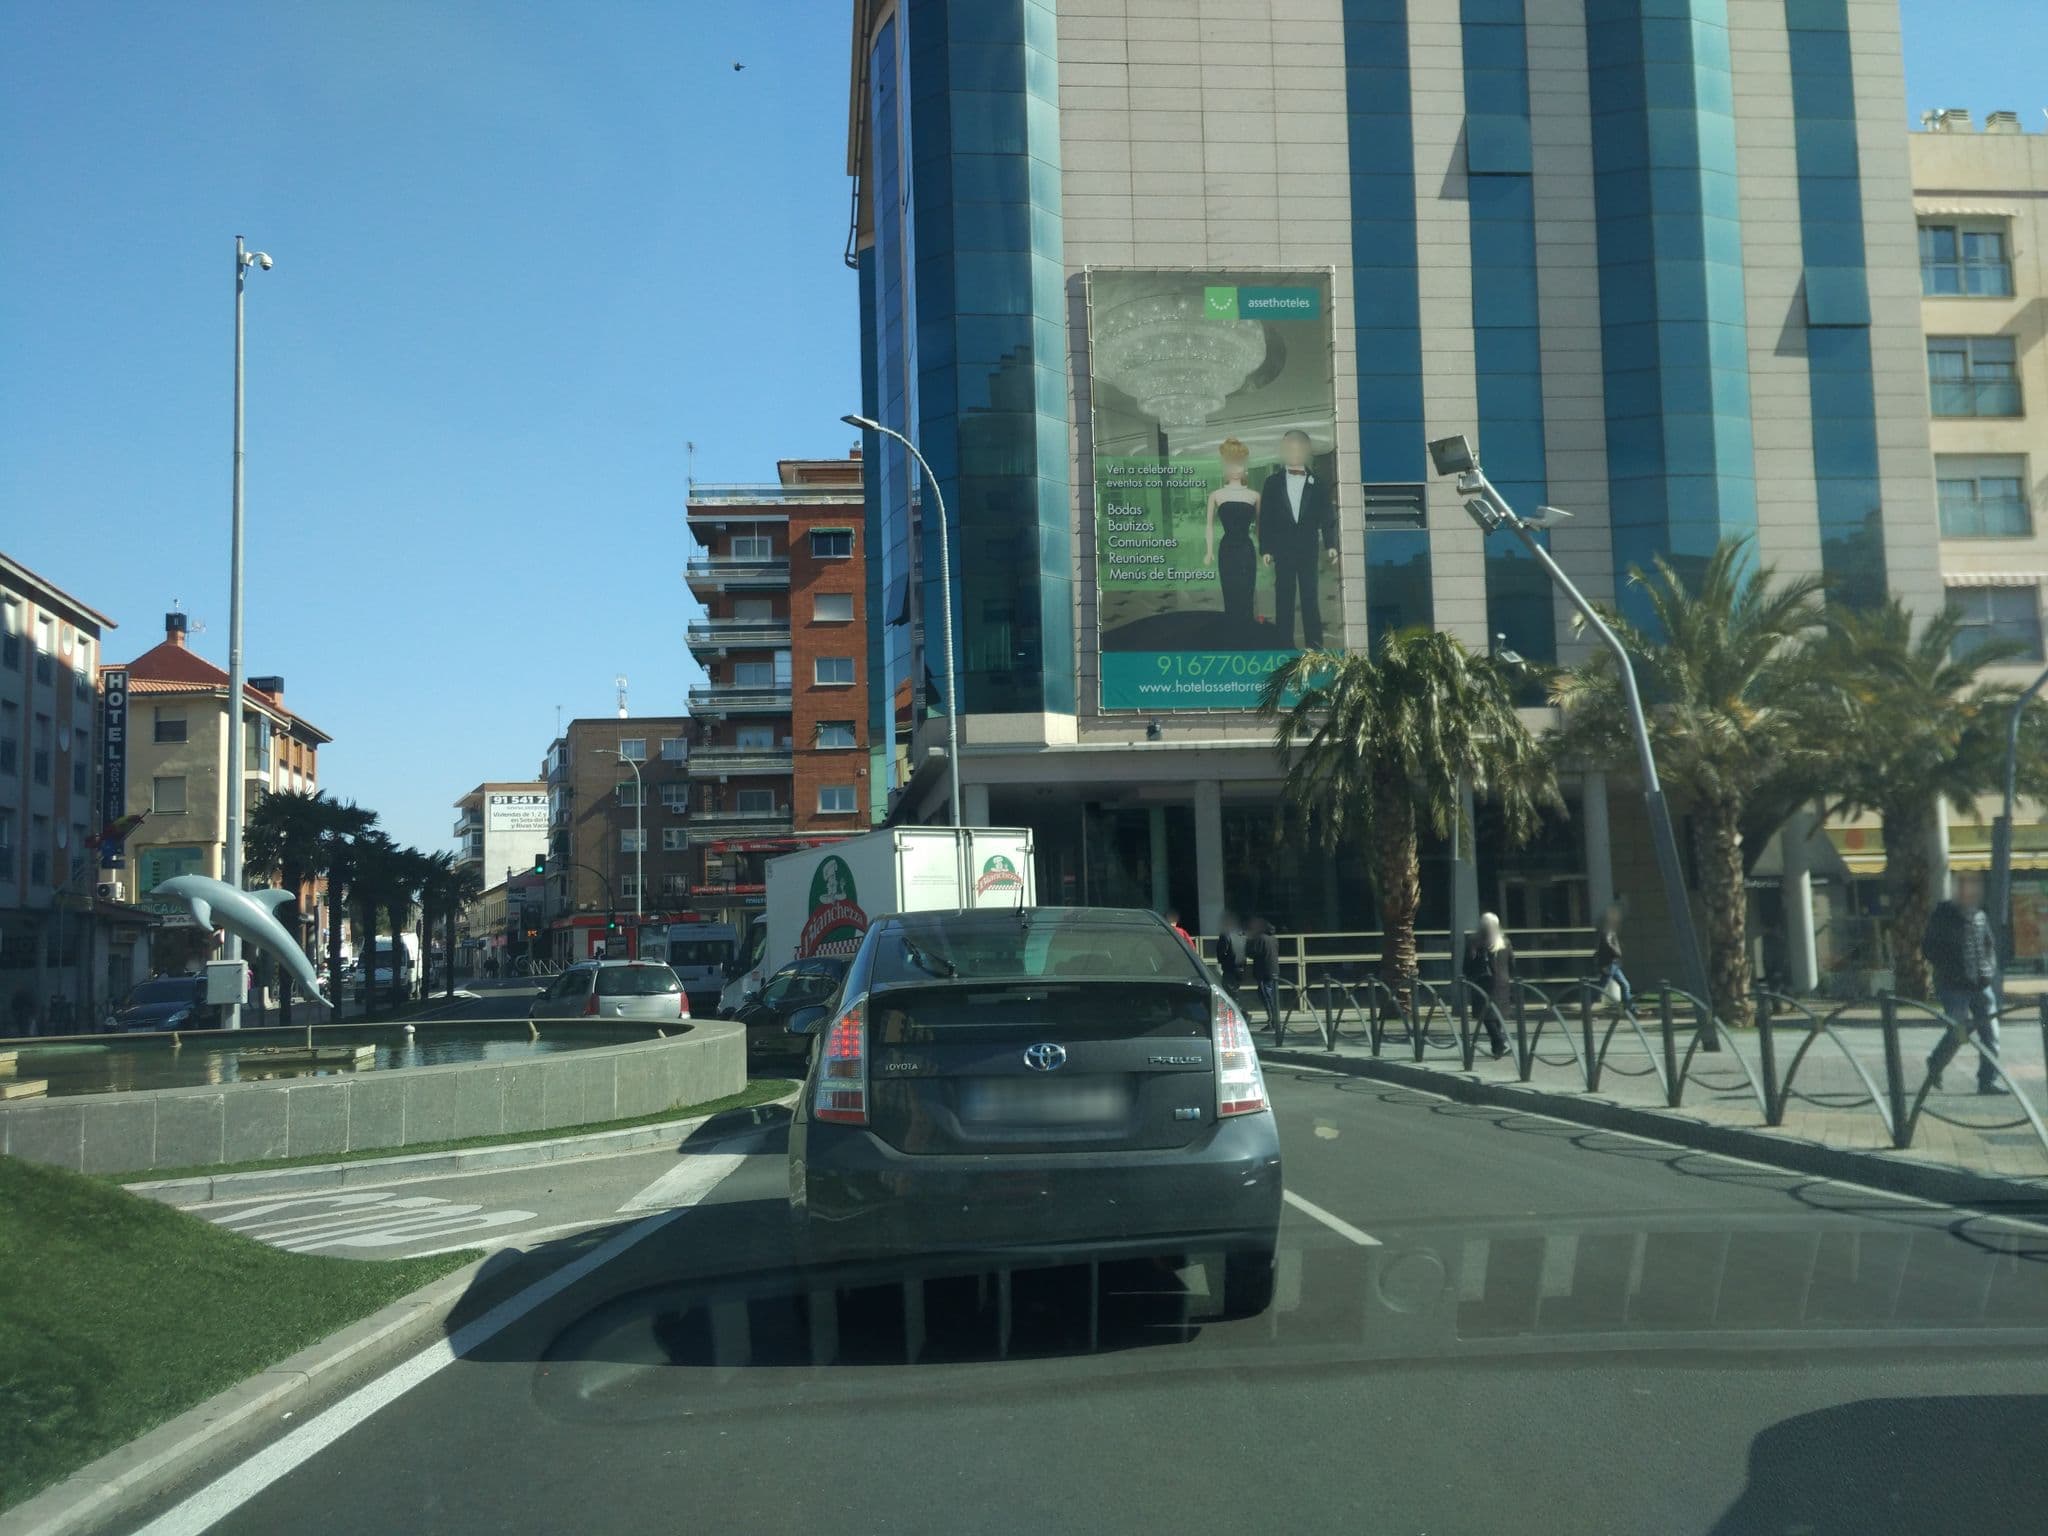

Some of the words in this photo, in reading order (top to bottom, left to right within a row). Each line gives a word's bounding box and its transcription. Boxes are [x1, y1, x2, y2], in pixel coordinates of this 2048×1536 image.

[1247, 297, 1310, 308] assethoteles
[1106, 464, 1125, 474] Ven
[1128, 466, 1135, 474] a
[1137, 464, 1178, 474] celebrar
[1180, 464, 1194, 474] tus
[1106, 479, 1143, 488] eventos
[1145, 480, 1163, 488] con
[1166, 479, 1207, 488] nosotros
[1107, 503, 1142, 515] Bodas
[1108, 520, 1154, 531] Bautizos
[1108, 536, 1177, 547] Comuniones
[1109, 552, 1165, 564] Reuniones
[1110, 568, 1147, 580] Menús
[1149, 568, 1164, 580] de
[1167, 568, 1215, 581] Empresa
[108, 673, 123, 760] HOTEL
[493, 796, 508, 804] 91
[511, 796, 534, 804] 541
[1147, 1056, 1202, 1065] PRIUS
[885, 1063, 918, 1072] TOYOTA
